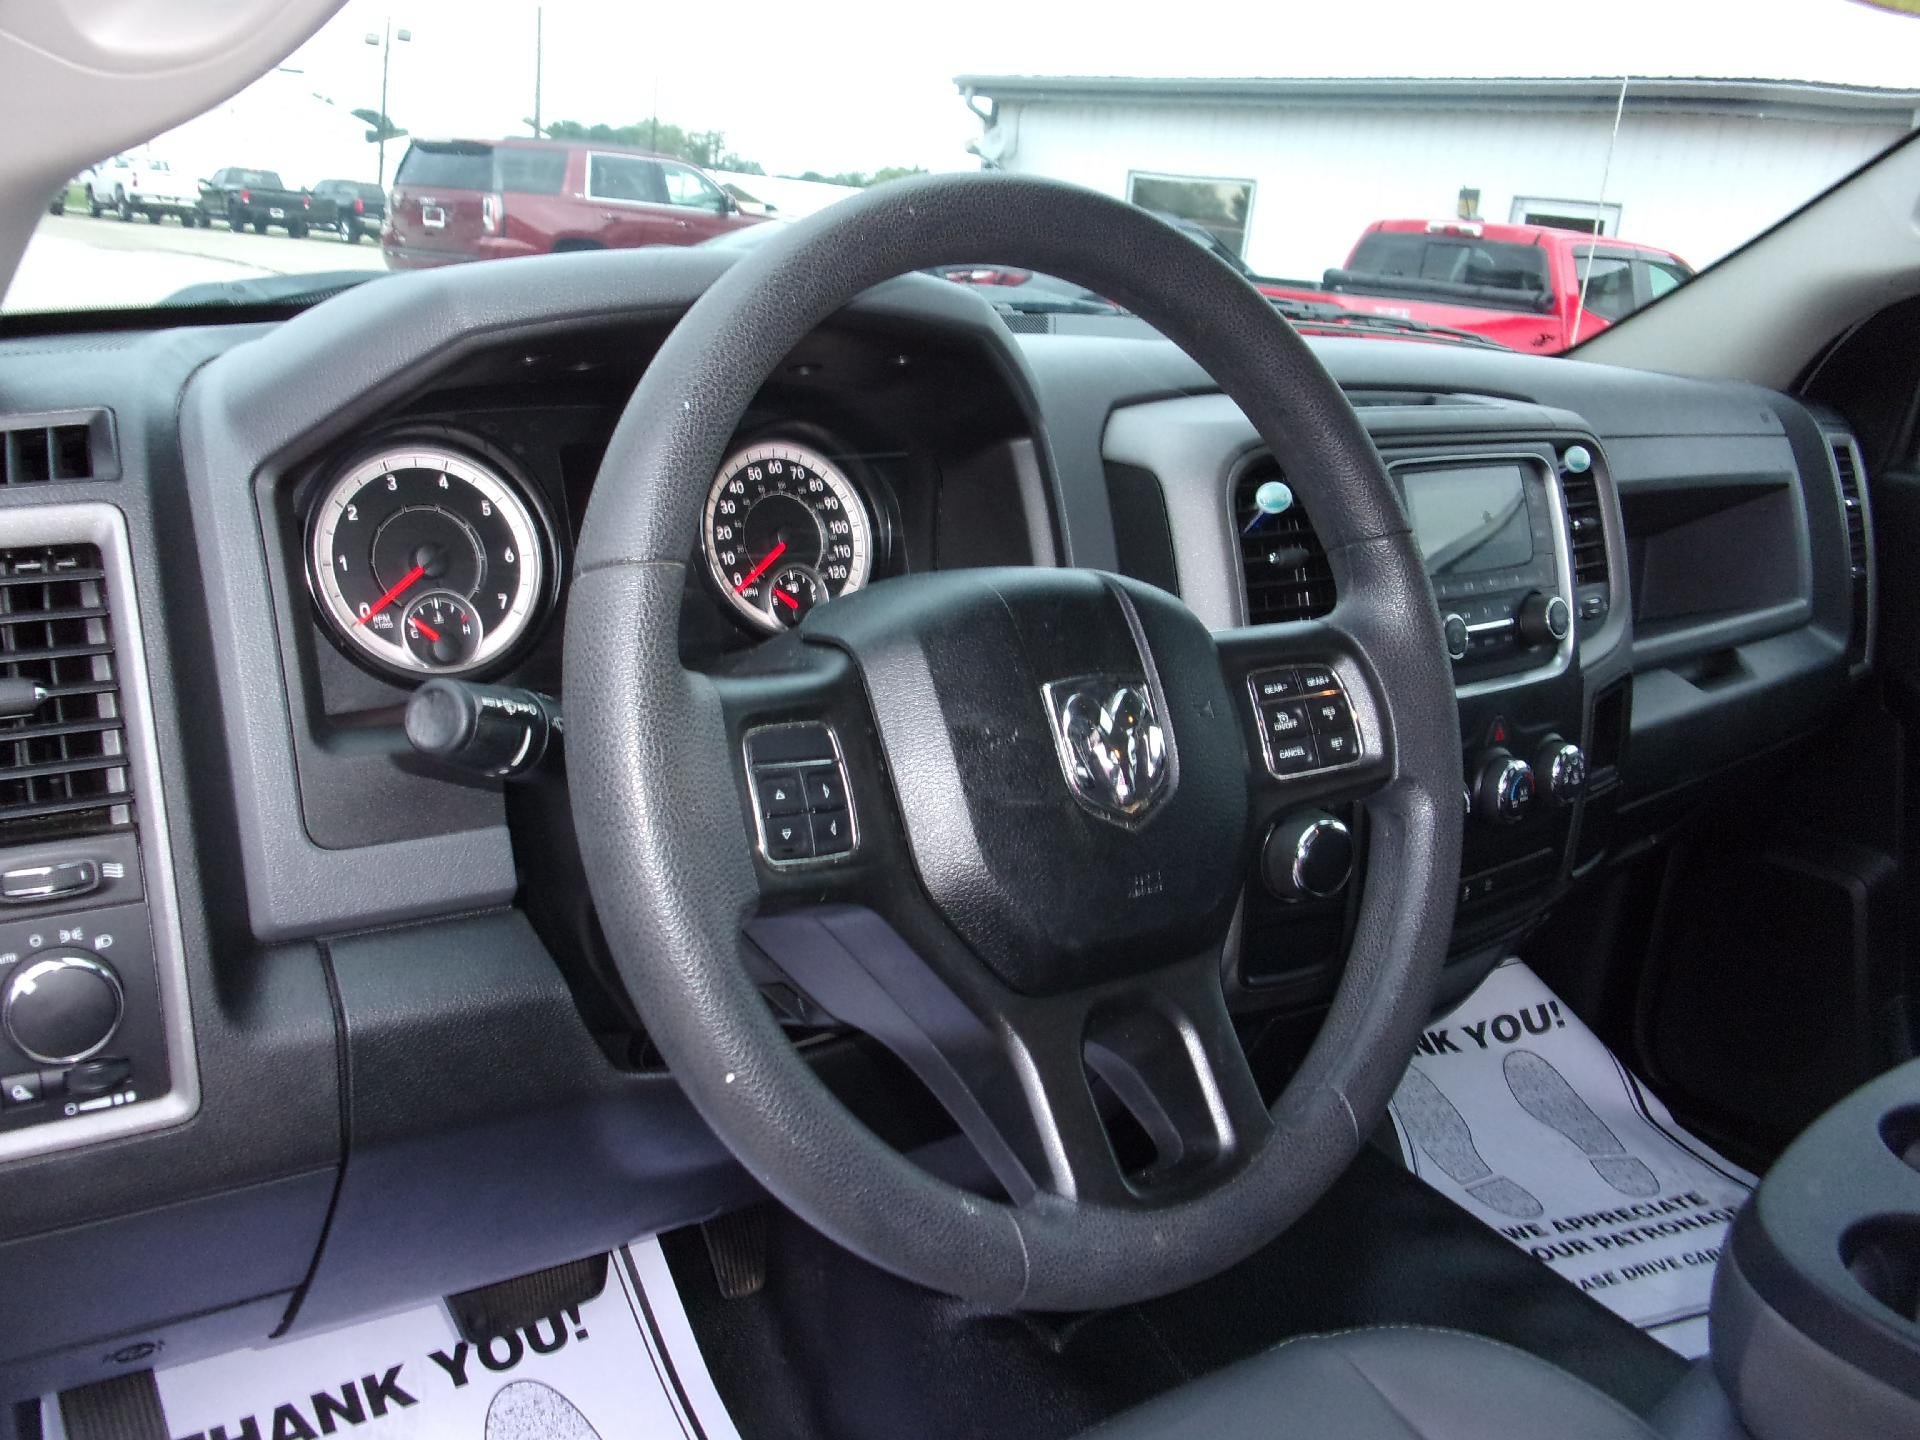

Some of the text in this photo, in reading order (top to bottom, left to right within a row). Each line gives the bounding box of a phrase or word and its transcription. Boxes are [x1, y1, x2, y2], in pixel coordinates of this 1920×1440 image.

[747, 467, 763, 481] 50
[768, 461, 783, 474] 60
[790, 466, 805, 480] 70
[386, 474, 398, 491] 3
[439, 473, 449, 490] 4
[729, 480, 744, 494] 40
[809, 479, 824, 493] 80
[481, 500, 492, 516] 5
[720, 500, 735, 515] 30
[824, 497, 839, 511] 90
[347, 504, 359, 521] 2
[716, 526, 732, 540] 20
[830, 521, 849, 535] 100
[505, 547, 515, 563] 6
[721, 551, 735, 566] 10
[833, 545, 851, 558] 110
[339, 555, 348, 571] 1
[734, 572, 743, 587] 0
[828, 565, 847, 580] 120
[498, 593, 507, 610] 7
[359, 602, 370, 619] 0
[462, 624, 470, 635] H
[1330, 737, 1343, 748] SET
[1280, 746, 1305, 759] CANCEL
[1460, 1000, 1566, 1050] YOU!
[1500, 1190, 1709, 1242] WE APPRECIATE
[1619, 1255, 1684, 1282] DRIVE
[427, 1304, 590, 1389] YOU!
